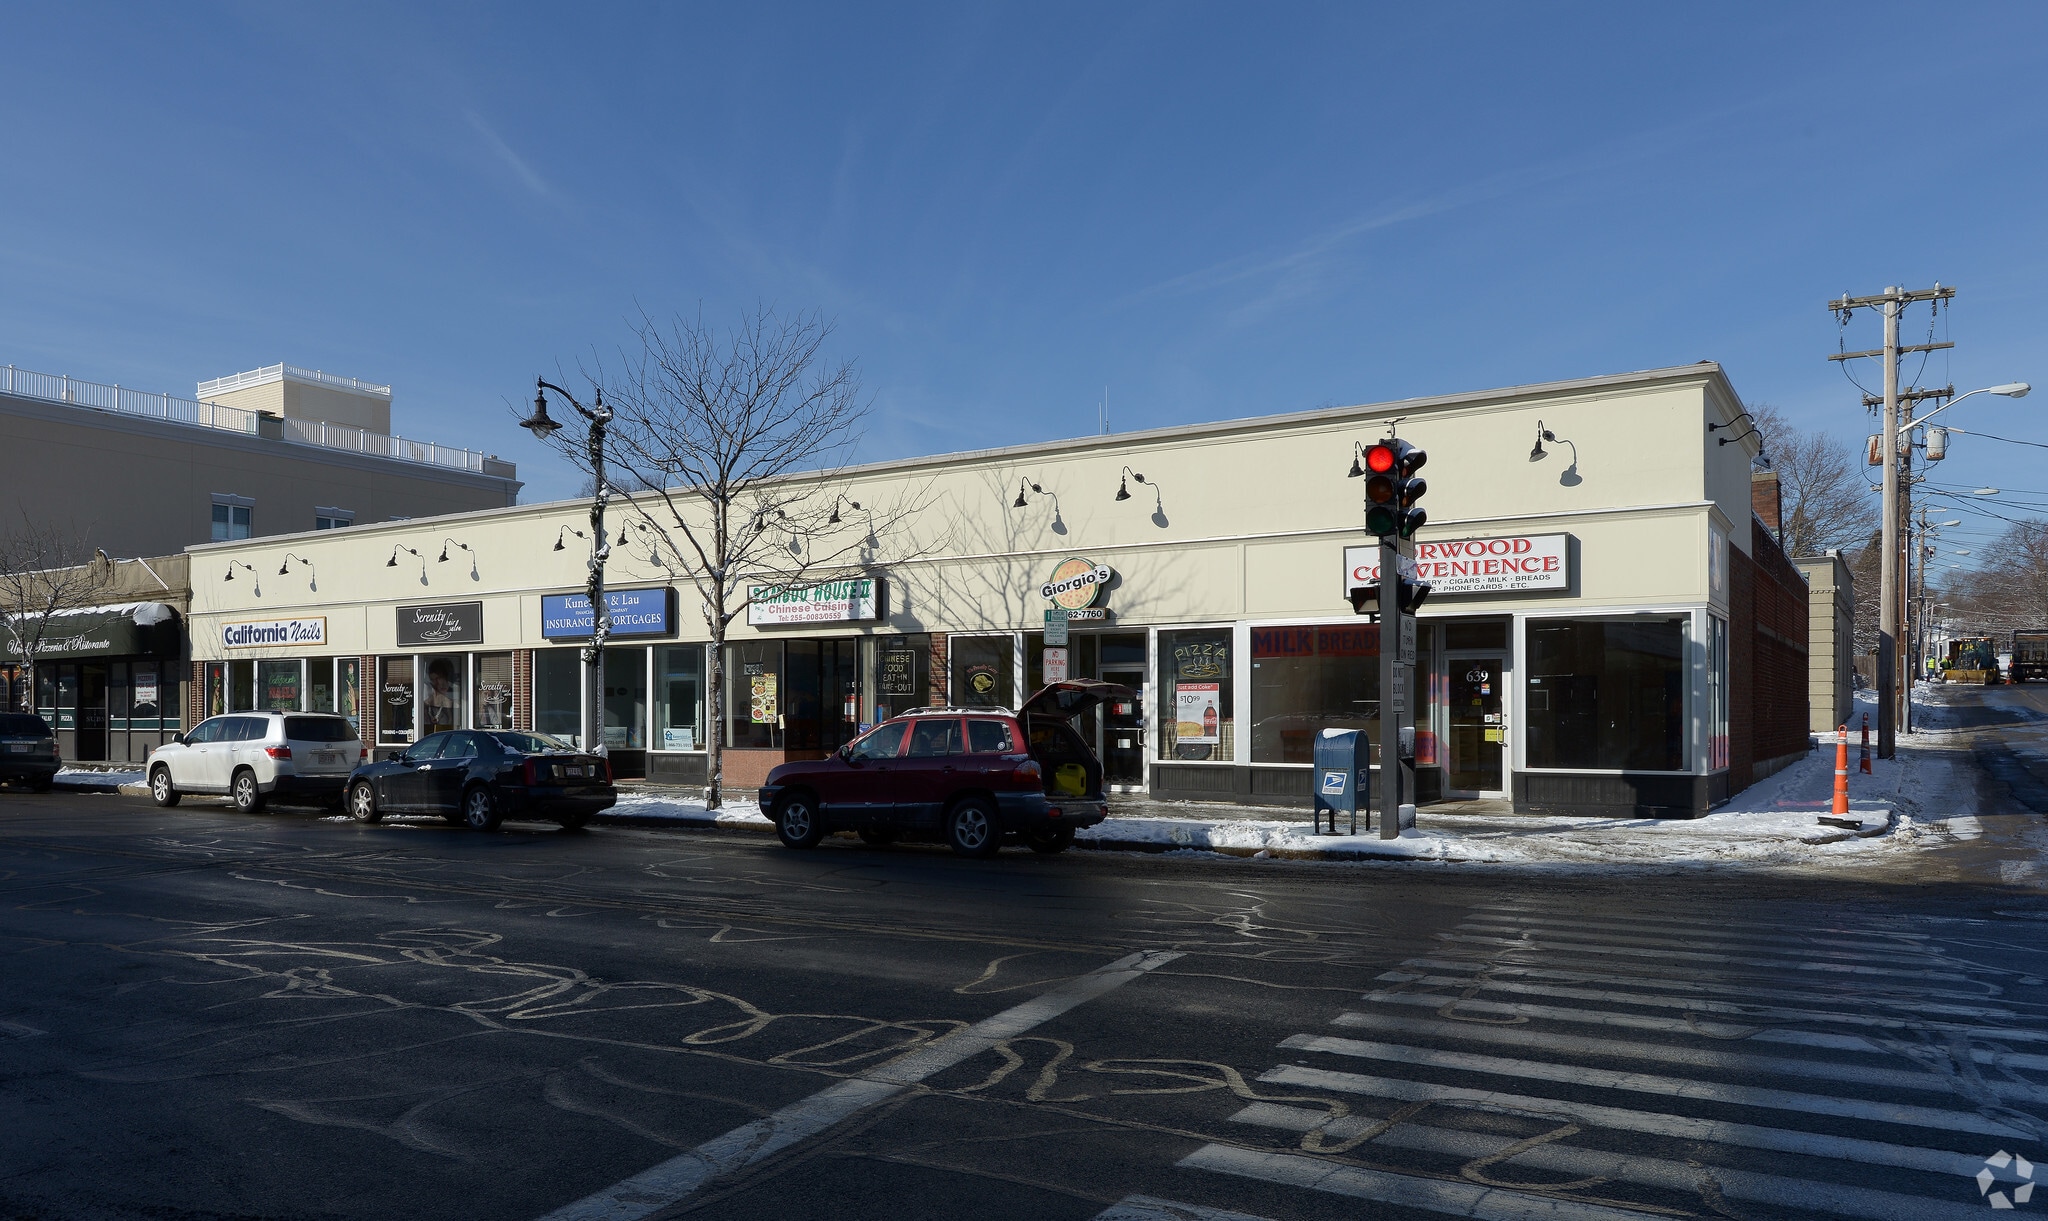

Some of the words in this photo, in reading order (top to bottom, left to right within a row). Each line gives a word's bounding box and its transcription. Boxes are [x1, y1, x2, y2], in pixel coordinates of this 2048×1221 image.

[1354, 556, 1560, 582] COVENIENCE
[1041, 568, 1108, 598] Giorgio's
[814, 580, 858, 602] HOUSE
[860, 580, 872, 598] II
[611, 595, 619, 605] &
[622, 594, 640, 605] Lau
[768, 603, 811, 614] Chinese
[814, 601, 854, 612] Cuisine
[413, 609, 446, 624] Serenity
[546, 617, 594, 629] INSURANCE
[611, 613, 662, 626] ORTGAGES
[225, 623, 287, 645] California
[290, 621, 321, 642] Nails
[1404, 620, 1412, 632] NO
[35, 639, 62, 653] Pizzeria
[63, 639, 70, 652] &
[71, 634, 110, 650] Ristorante
[1253, 629, 1313, 653] MILK
[1403, 635, 1413, 646] TURN
[1175, 643, 1227, 660] PIZZA
[1400, 649, 1406, 660] ON
[1466, 671, 1489, 682] 639
[383, 682, 405, 693] Serenity
[478, 680, 503, 691] Serenity
